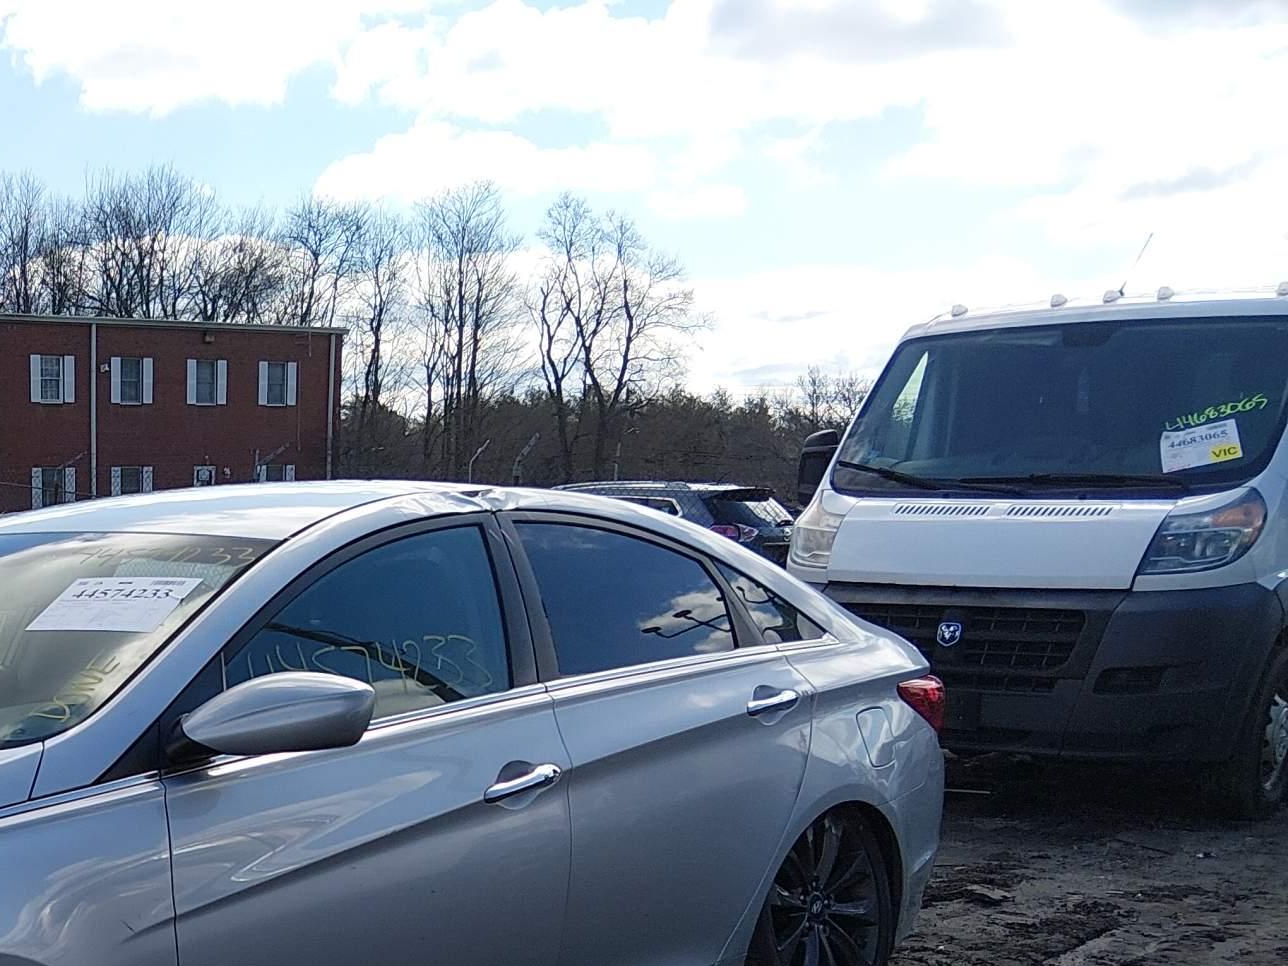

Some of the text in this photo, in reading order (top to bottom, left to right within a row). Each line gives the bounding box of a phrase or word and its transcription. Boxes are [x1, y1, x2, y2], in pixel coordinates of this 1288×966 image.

[1165, 393, 1268, 430] 44683065
[1168, 429, 1228, 448] 44683065
[1212, 446, 1238, 458] VIC
[72, 588, 174, 599] 44574233
